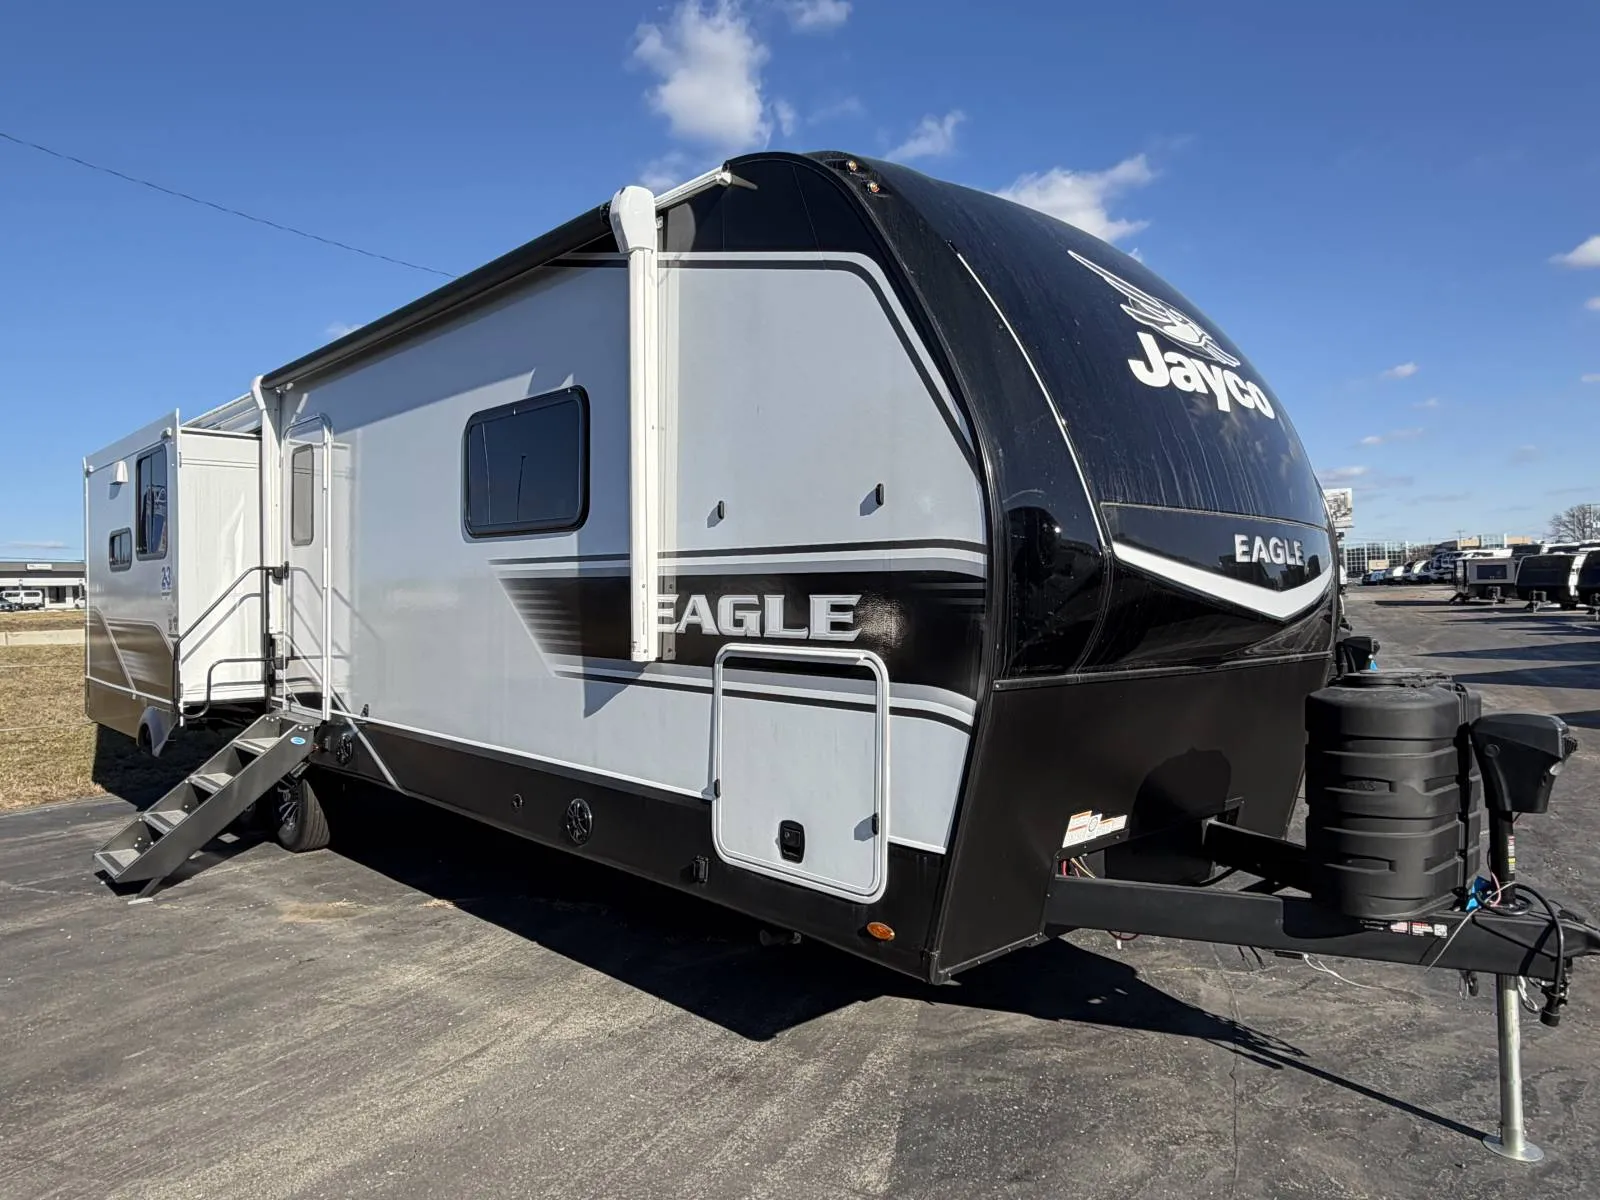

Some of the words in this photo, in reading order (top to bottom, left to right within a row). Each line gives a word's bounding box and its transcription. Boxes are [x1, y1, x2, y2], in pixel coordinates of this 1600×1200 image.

[1128, 331, 1276, 420] Jayco
[1234, 533, 1305, 566] EAGLE
[656, 593, 862, 642] EAGLE
